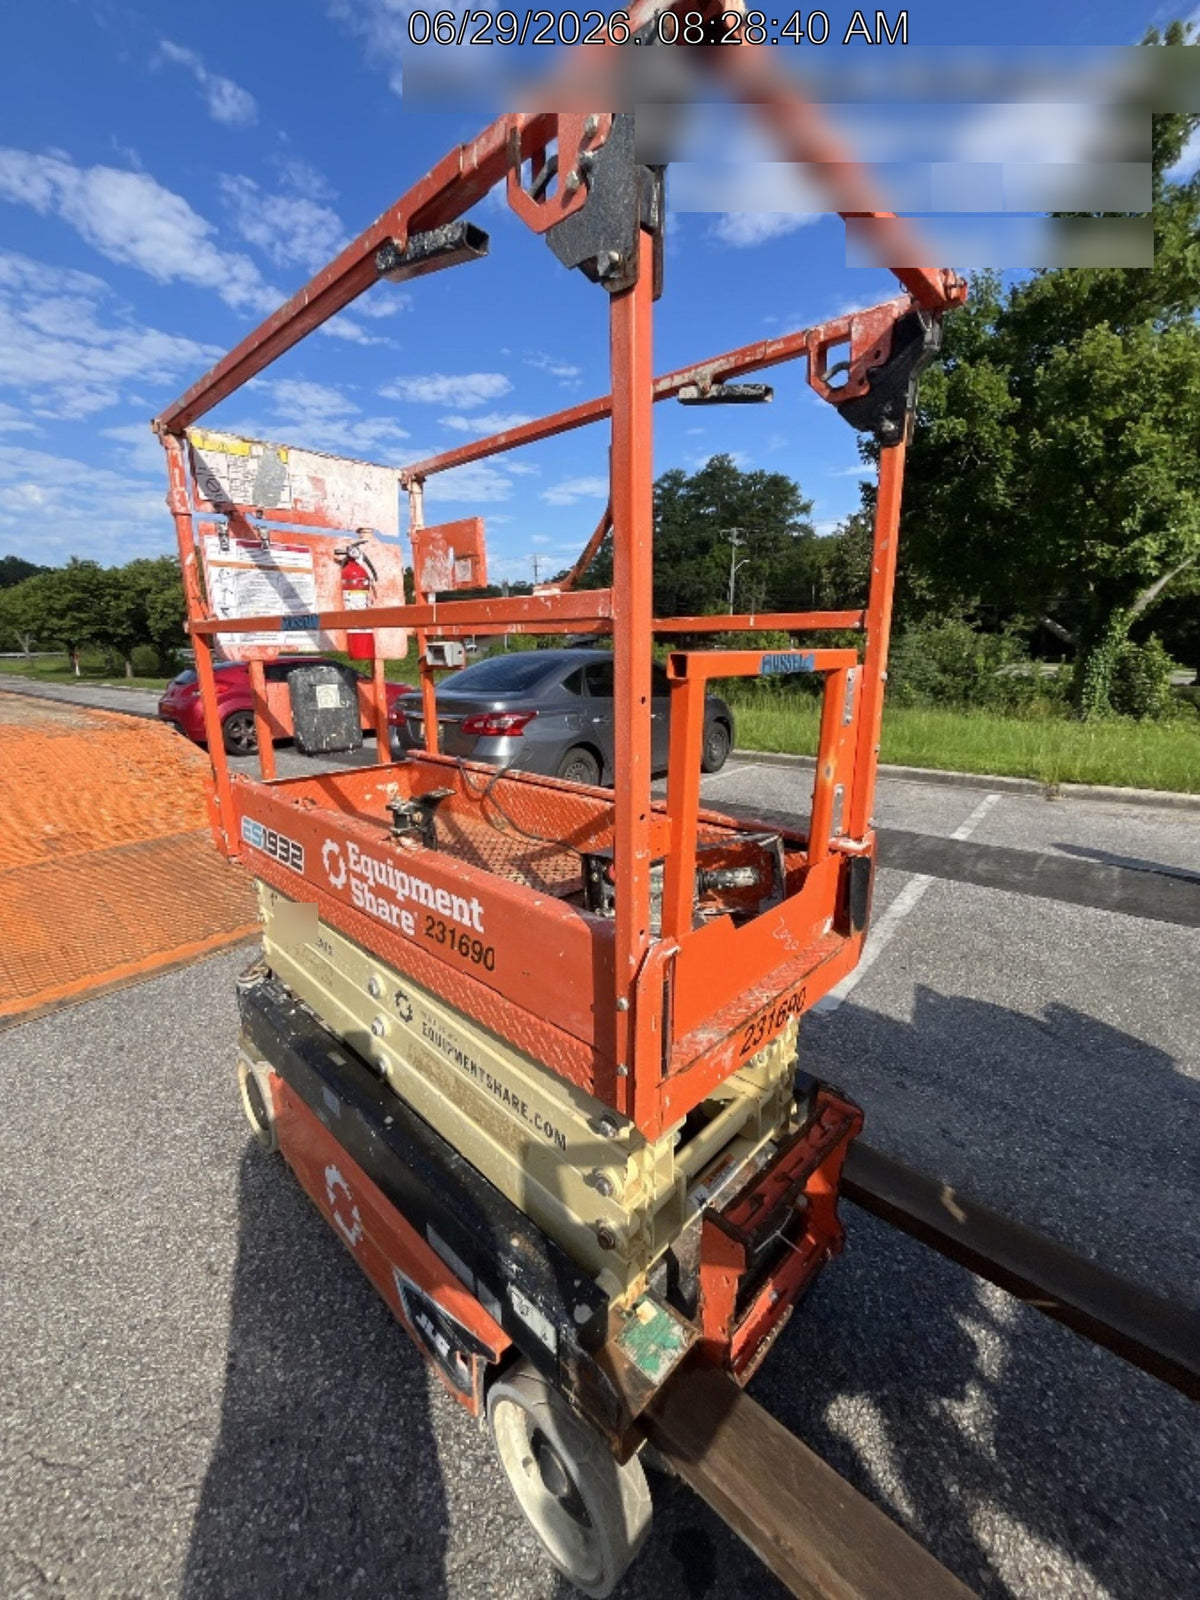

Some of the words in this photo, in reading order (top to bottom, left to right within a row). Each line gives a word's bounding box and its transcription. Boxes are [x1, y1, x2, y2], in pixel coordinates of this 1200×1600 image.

[242, 816, 304, 873] ES1932
[347, 841, 484, 932] Equipment
[350, 878, 415, 935] Share
[425, 916, 495, 971] 231690
[739, 986, 806, 1057] 231690
[422, 1021, 567, 1151] EQUIPMENTSHARE.COM
